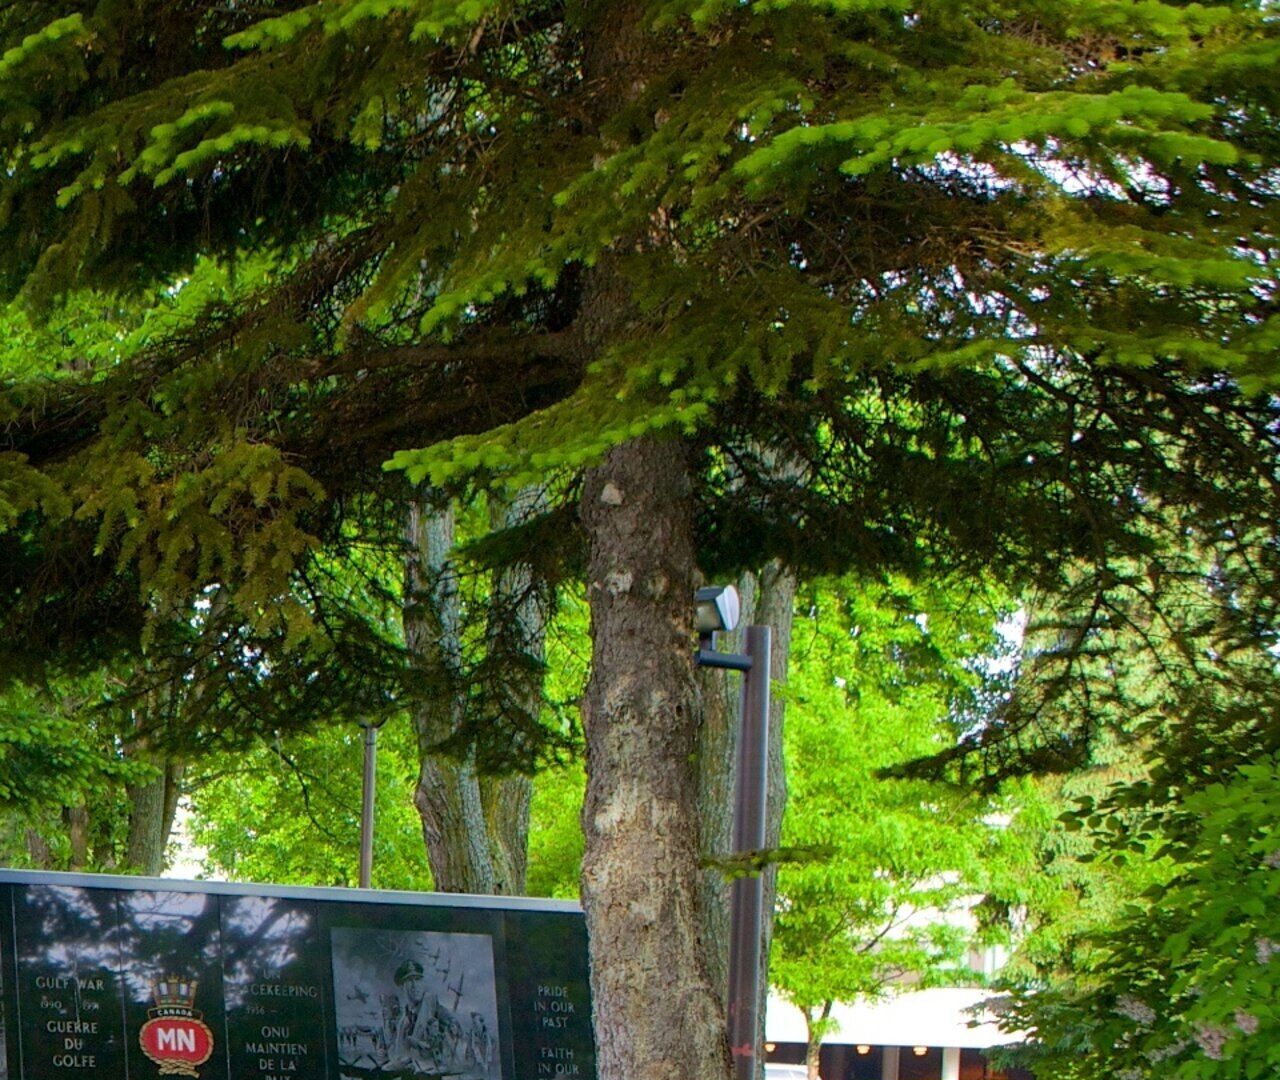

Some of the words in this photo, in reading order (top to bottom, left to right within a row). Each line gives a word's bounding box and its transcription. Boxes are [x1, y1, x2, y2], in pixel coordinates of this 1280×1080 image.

[36, 977, 70, 989] GULF
[77, 979, 104, 991] WAR
[538, 985, 568, 998] PRIDE
[157, 1008, 193, 1017] CANADA
[534, 1001, 547, 1012] IN
[550, 1002, 575, 1013] OUR
[47, 1020, 98, 1034] GUERRE
[542, 1017, 569, 1028] PAST
[261, 1026, 289, 1038] ONU
[64, 1038, 83, 1050] DU
[156, 1028, 196, 1052] MN
[246, 1042, 308, 1055] MAINTIEN
[542, 1048, 574, 1060] FAITH
[53, 1055, 96, 1068] GOLFE
[259, 1058, 275, 1070] DE
[280, 1059, 296, 1071] LA
[538, 1063, 551, 1074] IN
[555, 1063, 579, 1075] OUR
